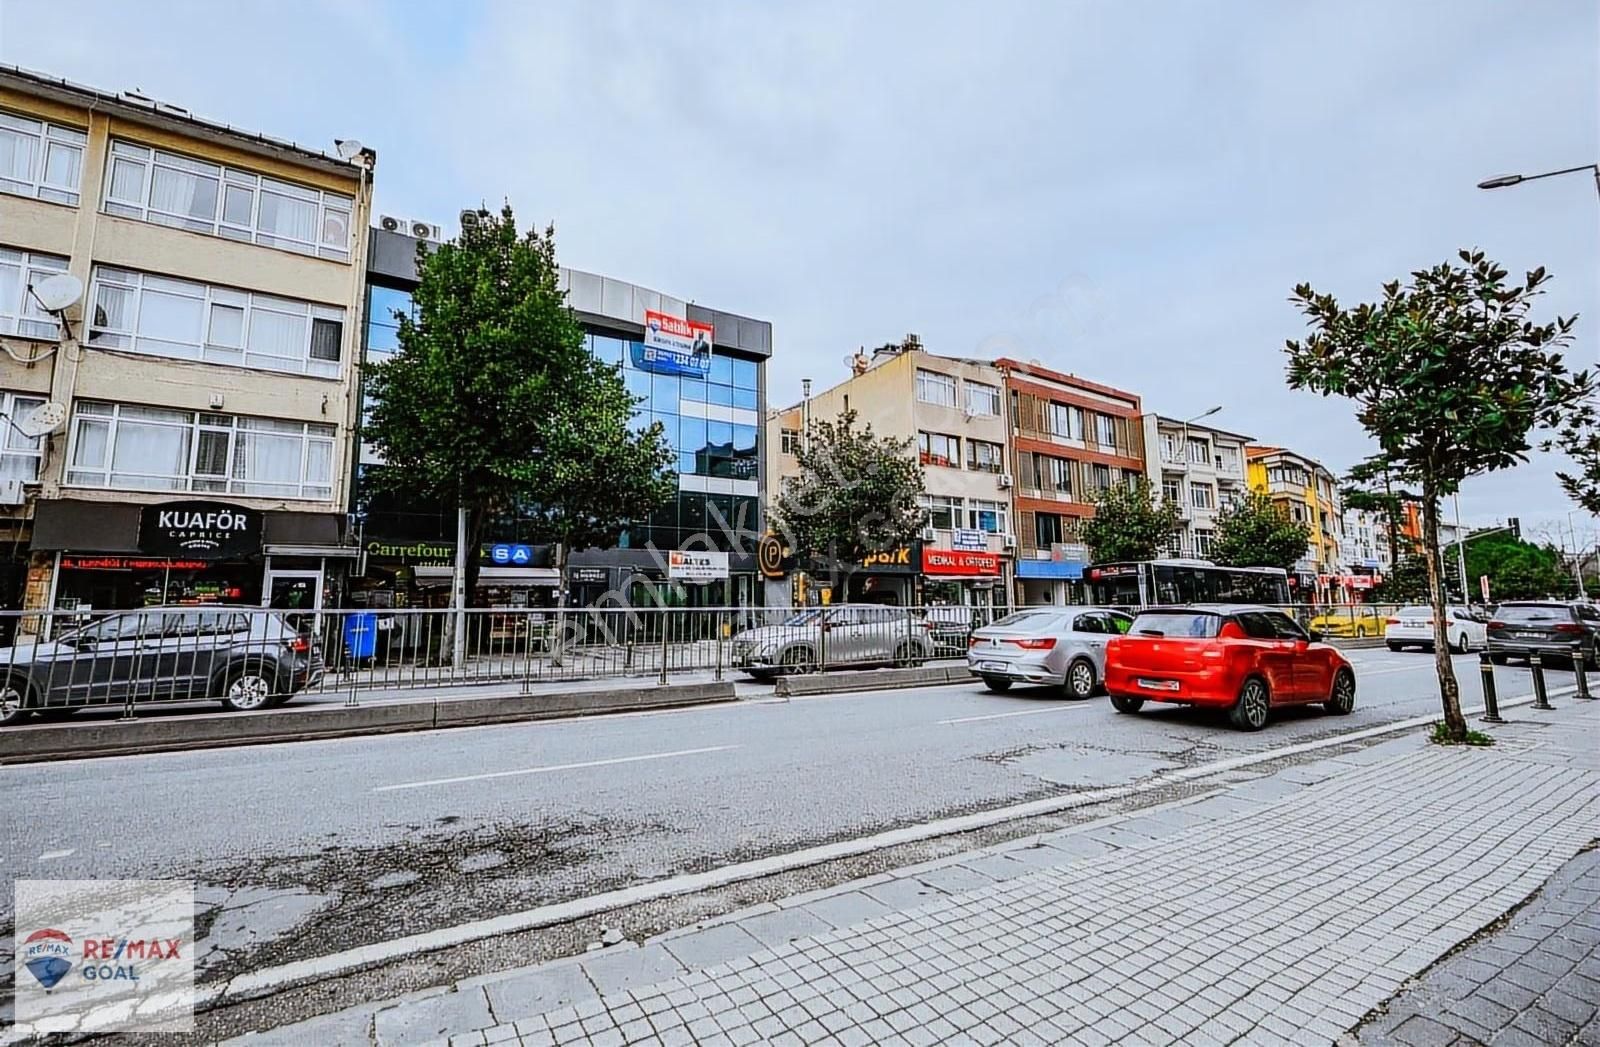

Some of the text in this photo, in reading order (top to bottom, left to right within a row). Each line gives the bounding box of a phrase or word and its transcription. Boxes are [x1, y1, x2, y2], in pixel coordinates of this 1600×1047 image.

[662, 317, 693, 337] Satılık
[158, 509, 248, 531] KUAFÖR
[169, 530, 231, 539] CAPRICE
[367, 541, 530, 561] Carrefour SA
